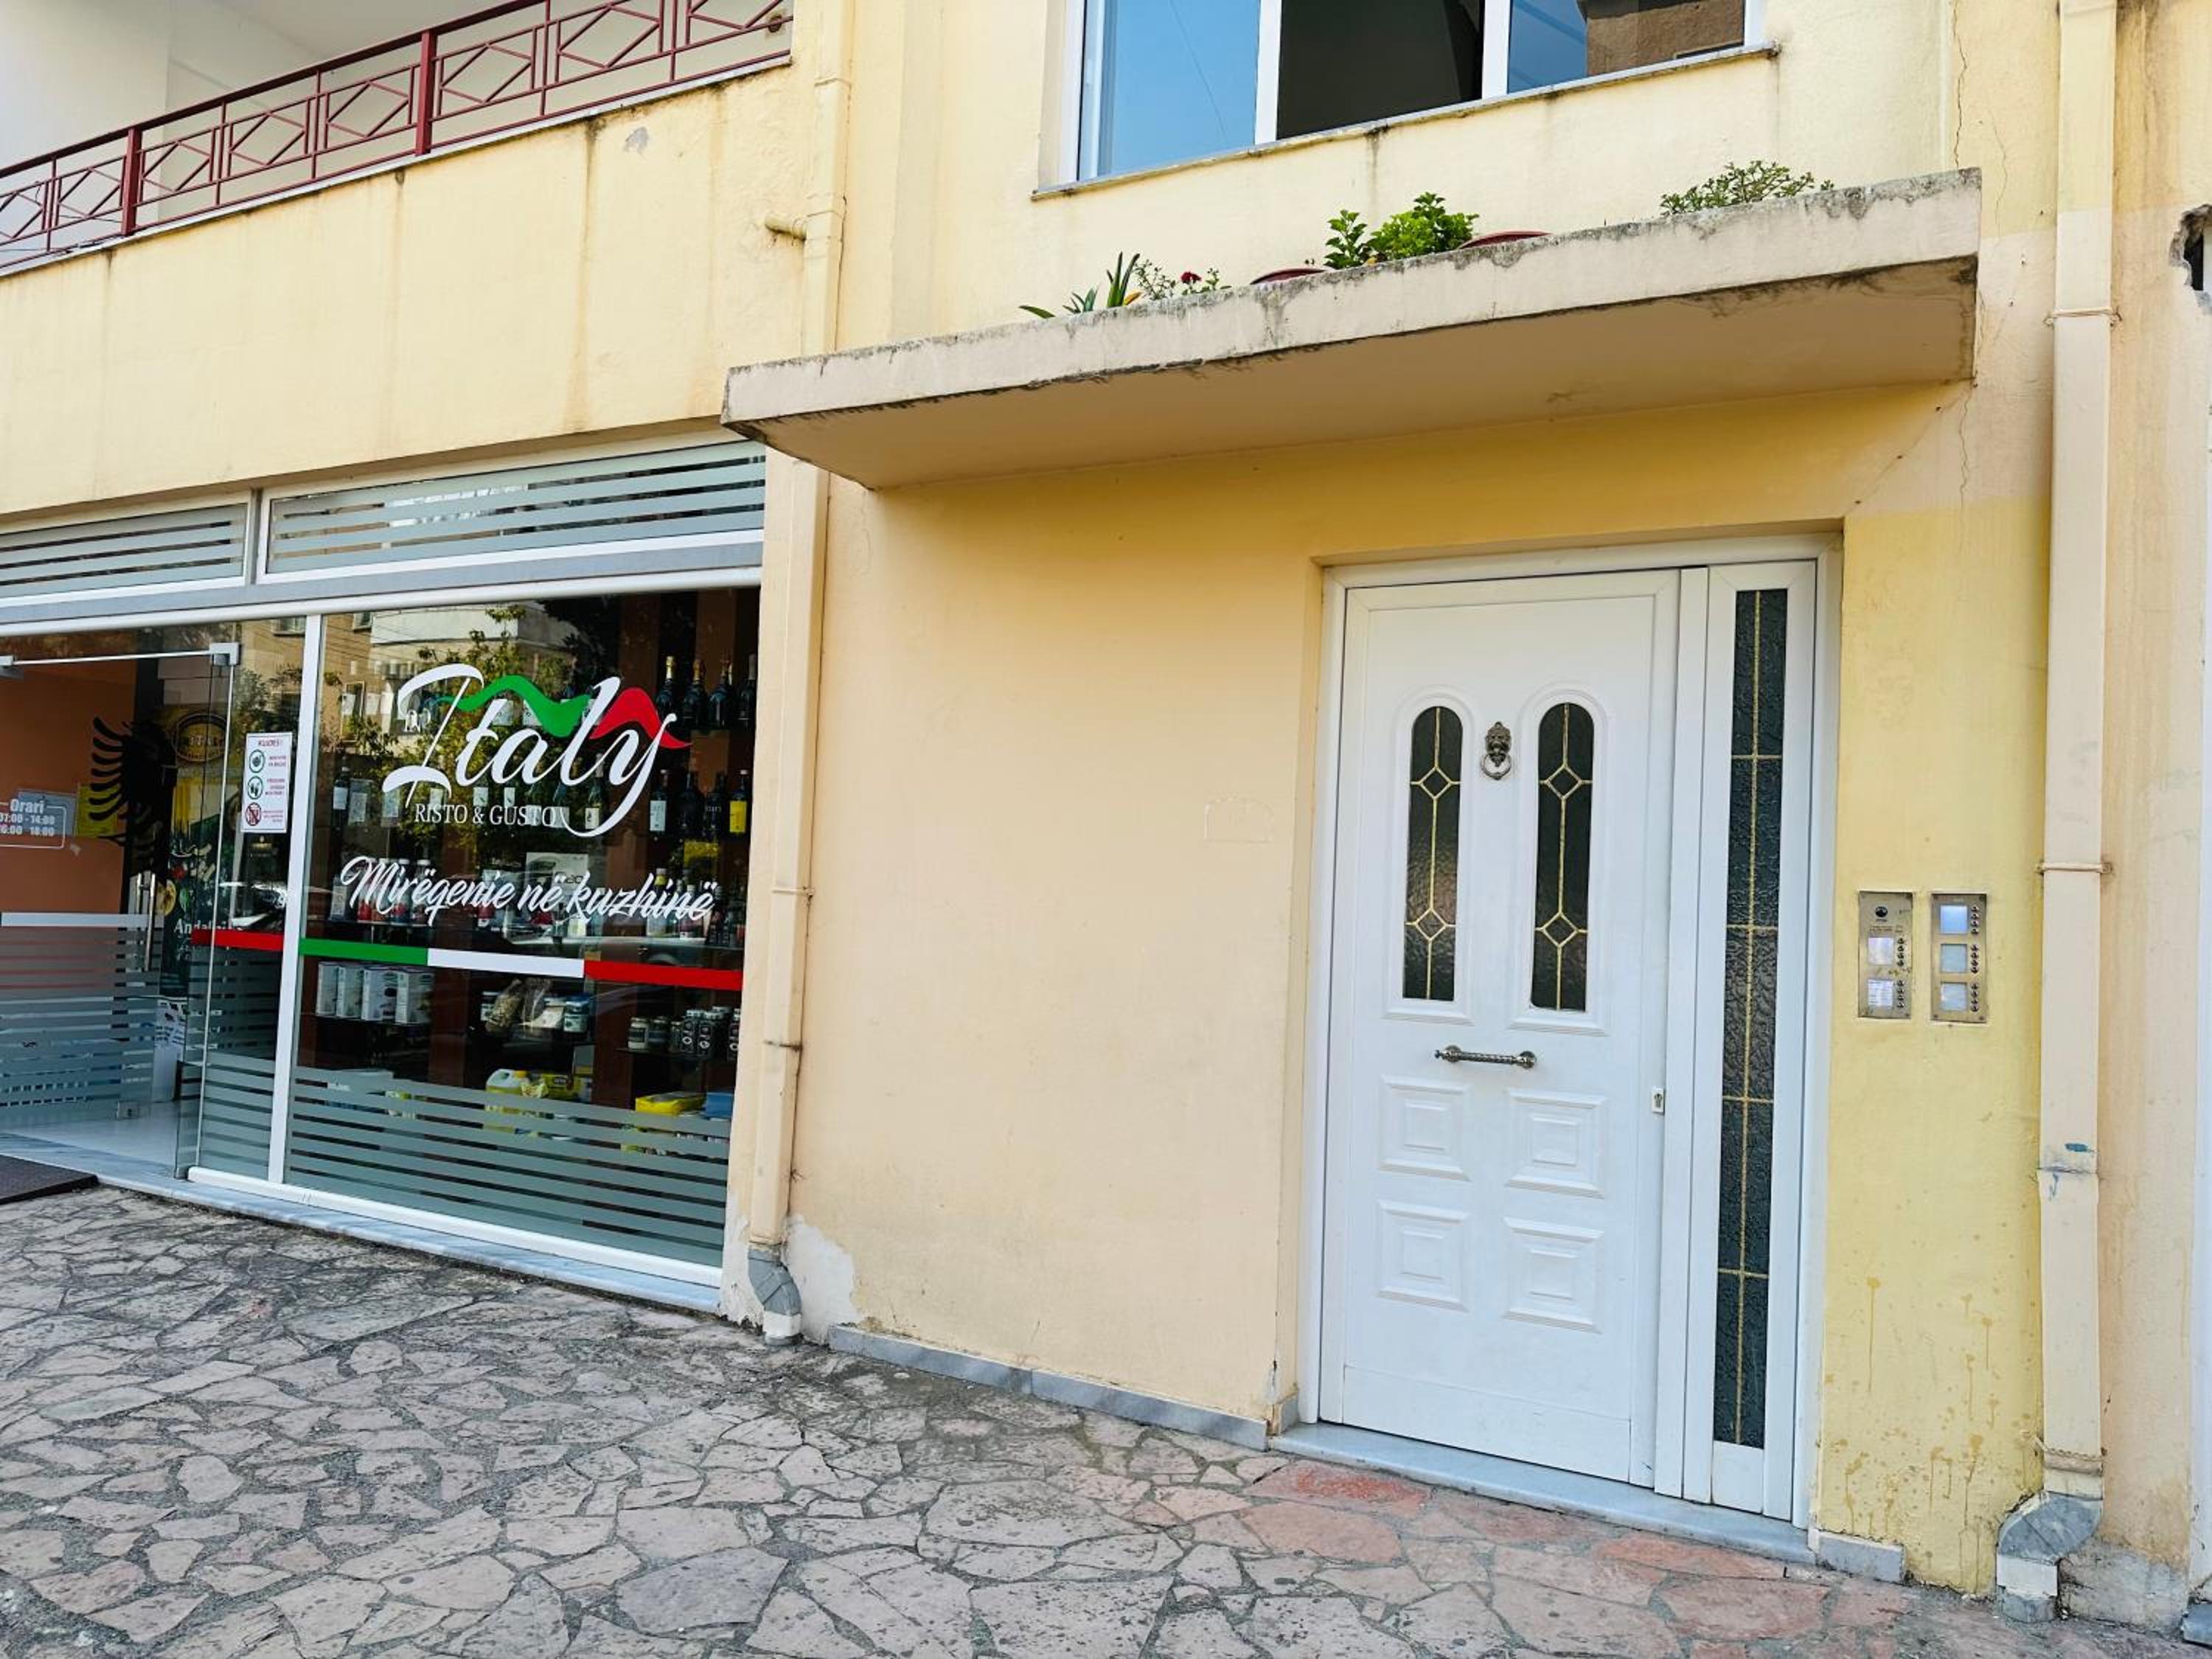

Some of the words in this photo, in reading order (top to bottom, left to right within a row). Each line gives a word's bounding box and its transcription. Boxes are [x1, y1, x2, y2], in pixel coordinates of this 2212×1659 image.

[382, 663, 678, 838] Italy
[10, 799, 44, 814] Orari
[414, 803, 467, 823] RISTO
[472, 807, 484, 824] &
[490, 804, 555, 827] GUSTO
[518, 874, 566, 913] në
[566, 870, 718, 922] kuzhinë
